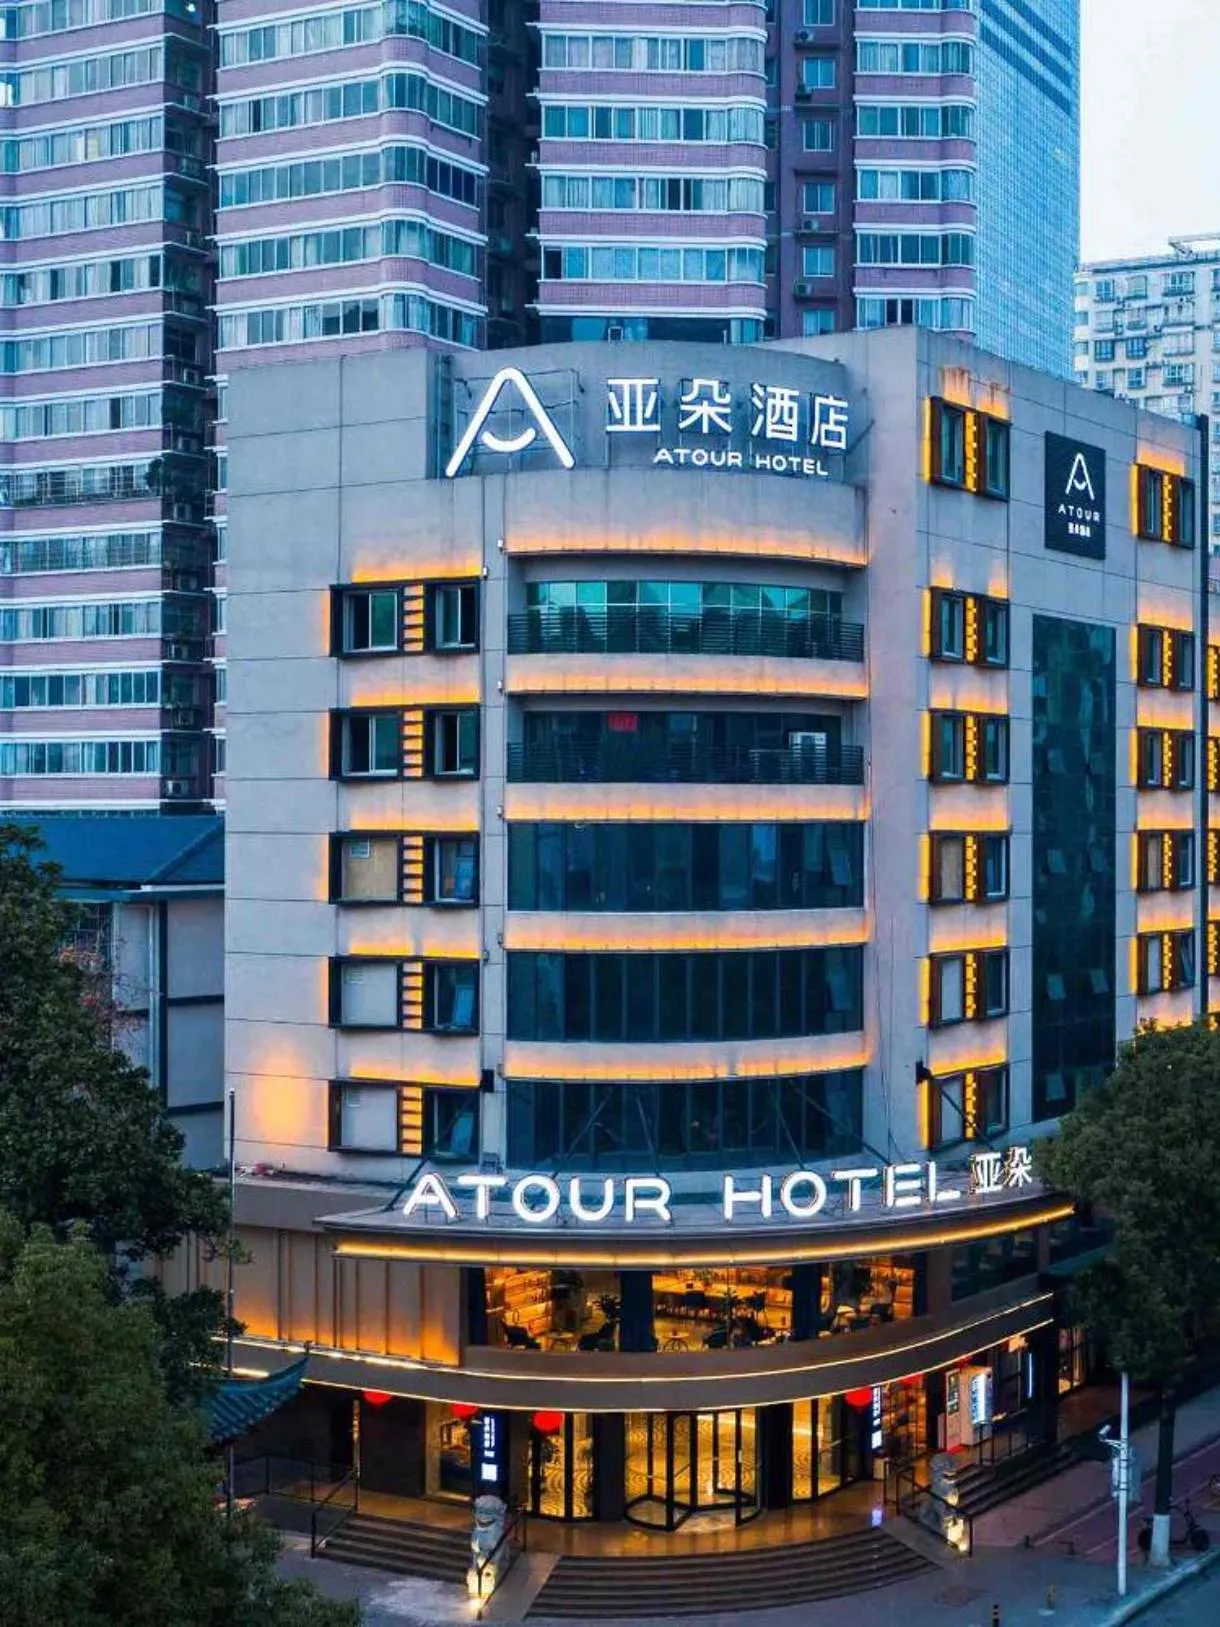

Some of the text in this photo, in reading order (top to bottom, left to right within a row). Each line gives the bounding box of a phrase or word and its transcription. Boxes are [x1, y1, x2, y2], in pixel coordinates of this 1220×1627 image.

[606, 377, 849, 450] 亚朵酒店
[653, 447, 829, 477] ATOUR HOTEL
[1058, 503, 1100, 523] ATOUR
[403, 1160, 962, 1223] ATOUR HOTEL
[970, 1145, 1033, 1195] 亚朵
